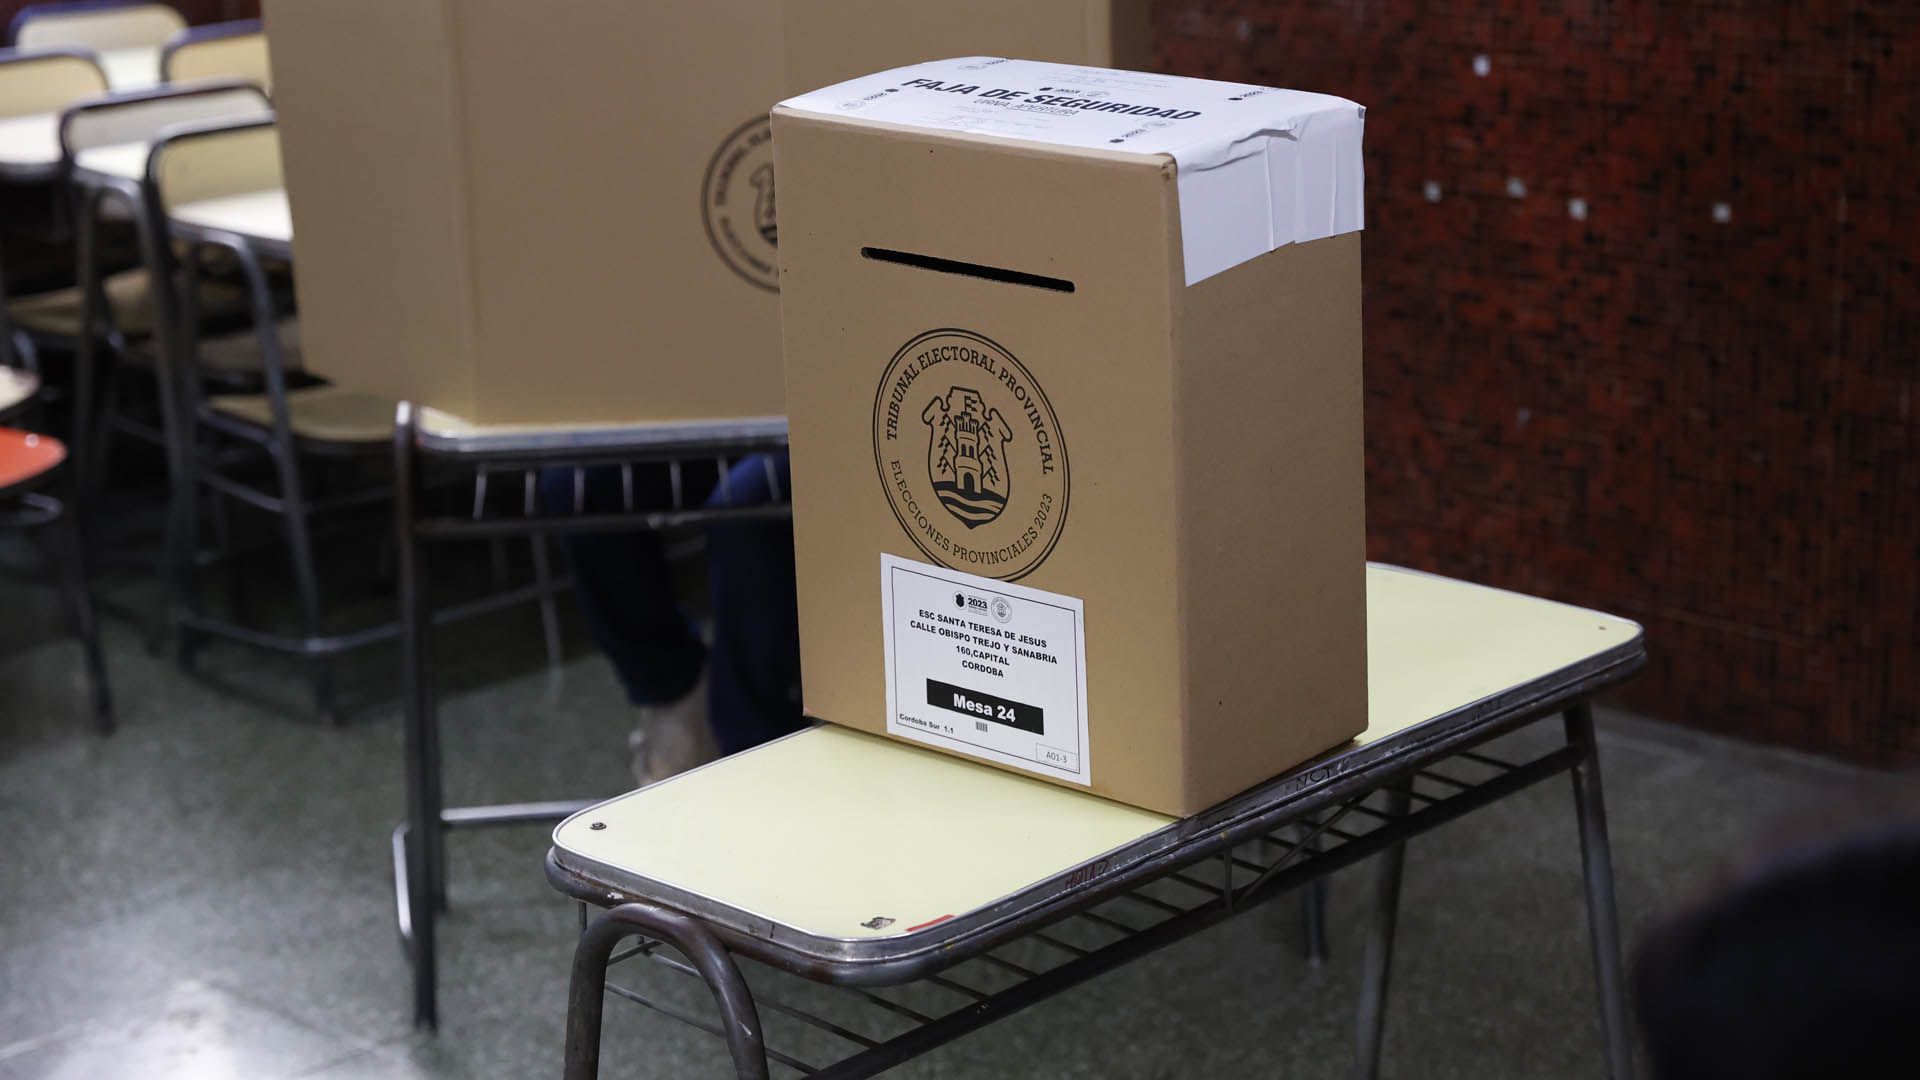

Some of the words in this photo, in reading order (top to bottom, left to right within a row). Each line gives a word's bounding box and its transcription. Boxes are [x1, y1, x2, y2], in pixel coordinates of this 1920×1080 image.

[901, 78, 980, 95] FAJA
[978, 88, 1029, 101] DE
[1024, 94, 1202, 120] SEGURIDAD
[886, 363, 920, 441] TRIBUNAL
[918, 346, 996, 376] ELECTORAL
[998, 367, 1055, 475] PROVINCIAL
[890, 459, 951, 552] ELECCIONES
[952, 526, 1039, 565] PROVINCIALES
[1035, 492, 1053, 530] 2023
[968, 597, 988, 609] 2023
[910, 620, 937, 635] CALLE
[939, 627, 971, 643] OBISPO
[972, 636, 1001, 651] TREJO
[1003, 643, 1010, 653] Y
[1012, 646, 1058, 665] SANABRIA
[919, 609, 935, 621] ESC
[937, 613, 966, 629] SANTA
[968, 621, 1002, 638] TERESA
[1004, 630, 1016, 642] DE
[1018, 633, 1047, 649] JESUS
[956, 645, 1010, 666] 160,CAPITAL
[962, 660, 1004, 678] CORDOBA
[953, 692, 993, 717] Mesa
[997, 705, 1016, 723] 24
[899, 713, 927, 727] Cordoba
[928, 719, 941, 731] Sur
[944, 723, 954, 734] 1.1
[1045, 750, 1068, 764] A01-3
